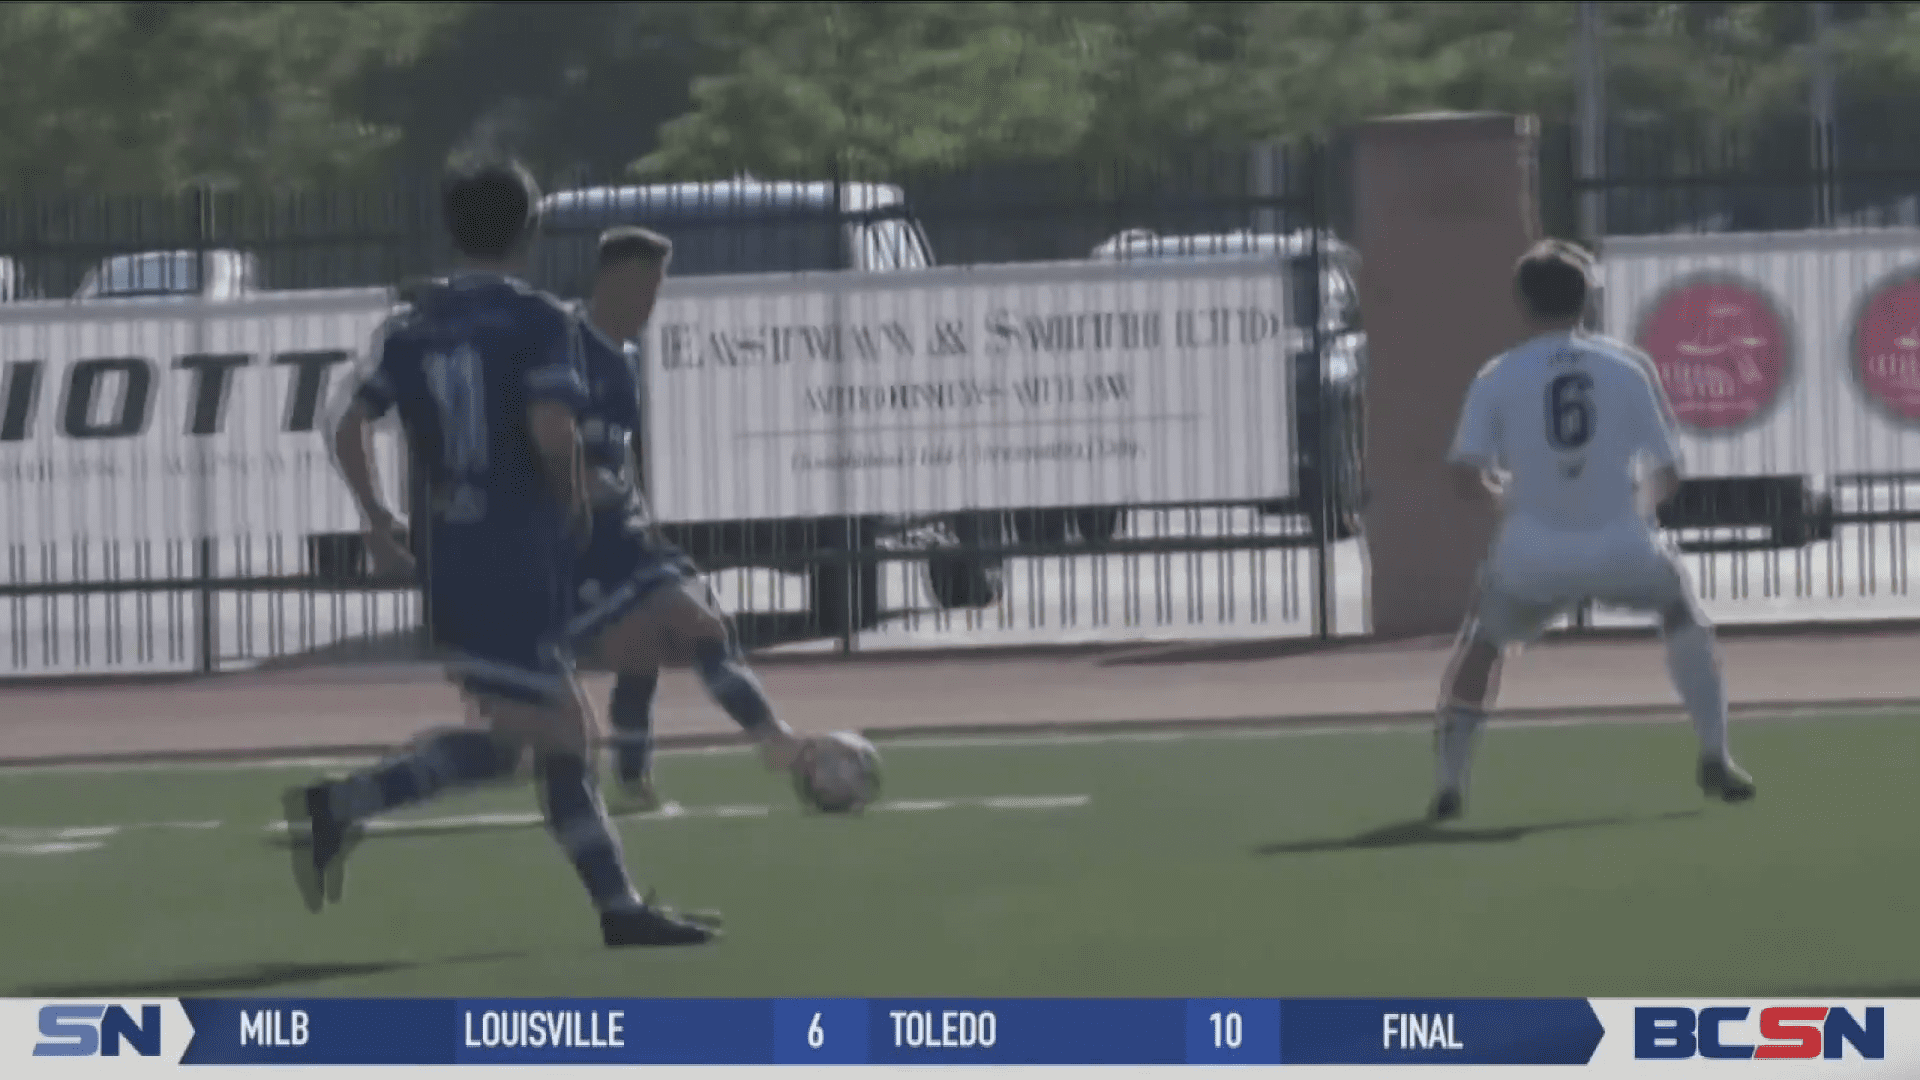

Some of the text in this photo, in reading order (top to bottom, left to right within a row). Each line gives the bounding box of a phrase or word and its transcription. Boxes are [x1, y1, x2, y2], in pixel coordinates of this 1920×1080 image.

[928, 320, 969, 355] &
[0, 350, 354, 441] IOTT
[1545, 371, 1598, 450] 6
